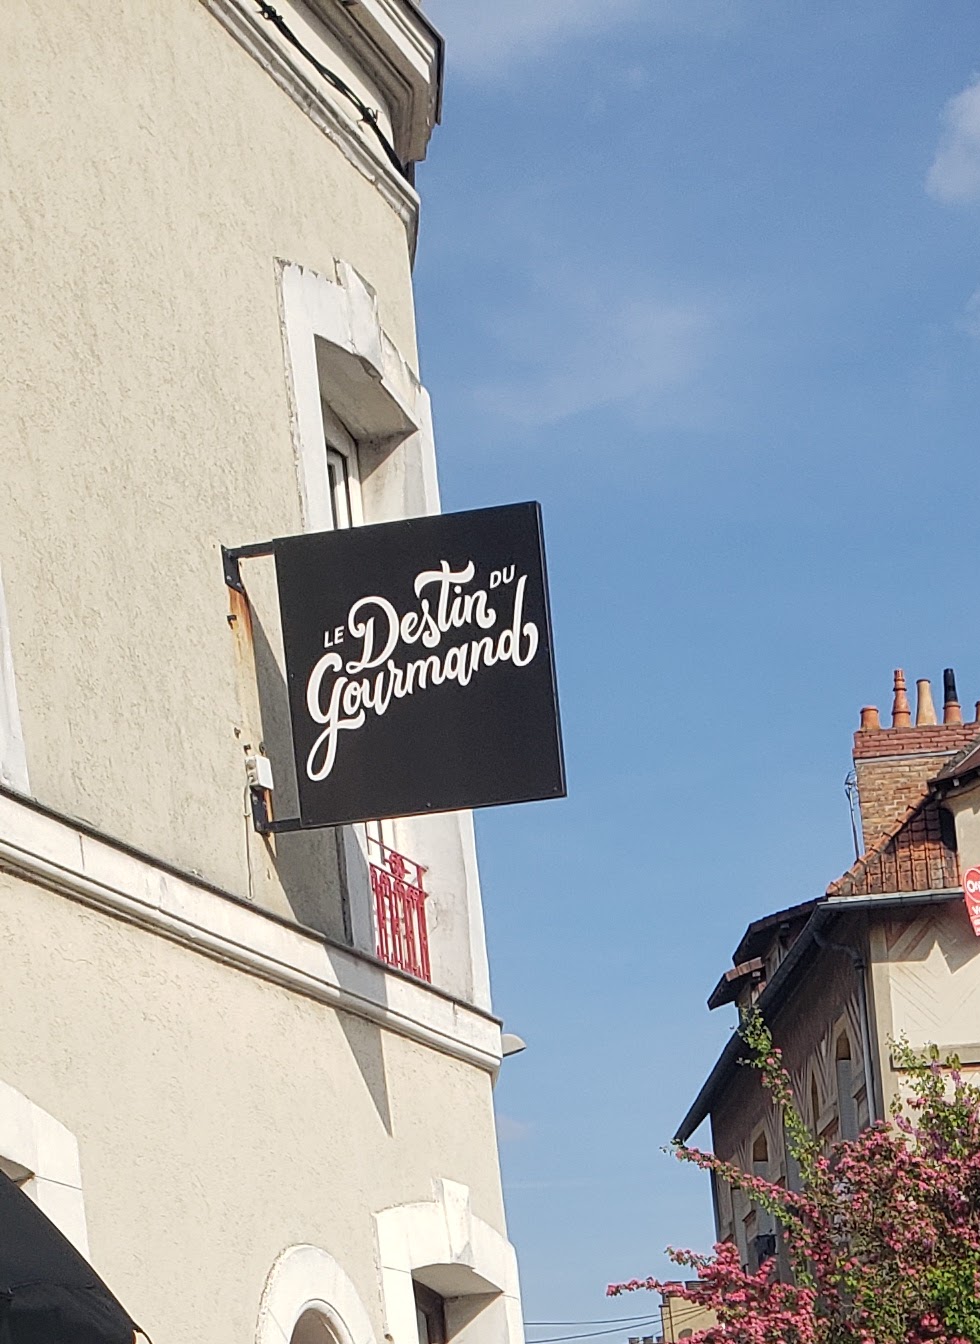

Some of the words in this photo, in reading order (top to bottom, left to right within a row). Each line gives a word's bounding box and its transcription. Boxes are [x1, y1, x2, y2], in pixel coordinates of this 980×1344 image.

[306, 574, 539, 782] Gourmand
[323, 625, 345, 648] LE
[346, 559, 497, 674] Destin
[489, 564, 516, 589] DU
